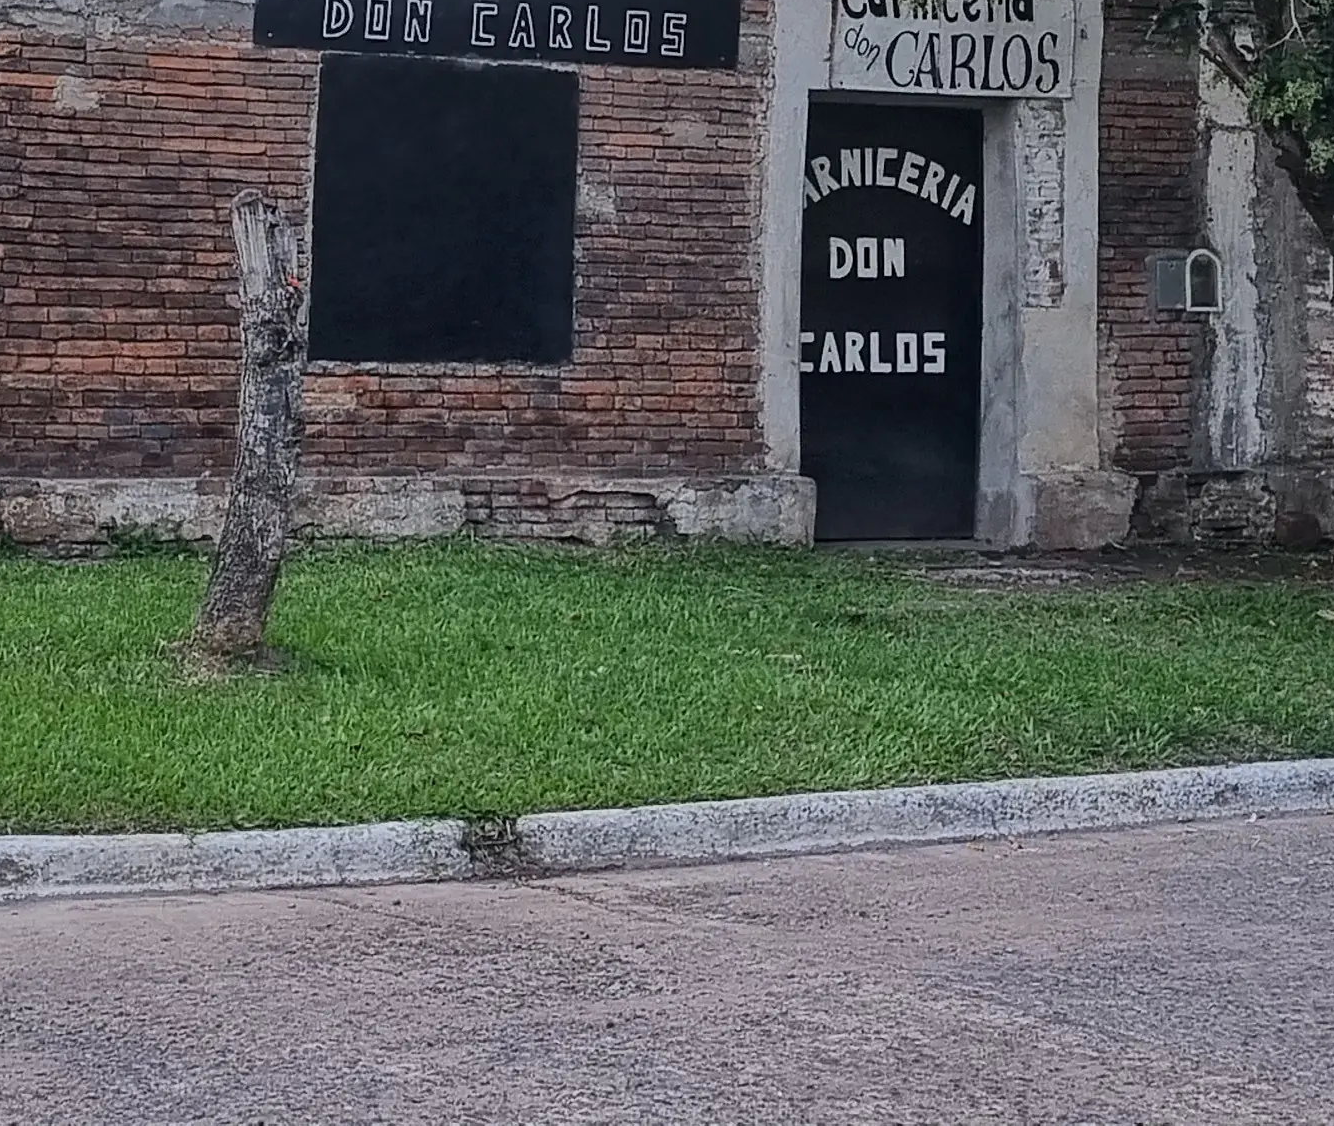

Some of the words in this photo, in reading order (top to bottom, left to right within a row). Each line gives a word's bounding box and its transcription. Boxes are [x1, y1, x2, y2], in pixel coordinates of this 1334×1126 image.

[470, 2, 688, 58] CARLOS
[844, 23, 881, 72] don
[885, 30, 1060, 94] CARLOS
[801, 147, 977, 226] ARNICERIA
[829, 236, 905, 279] DON
